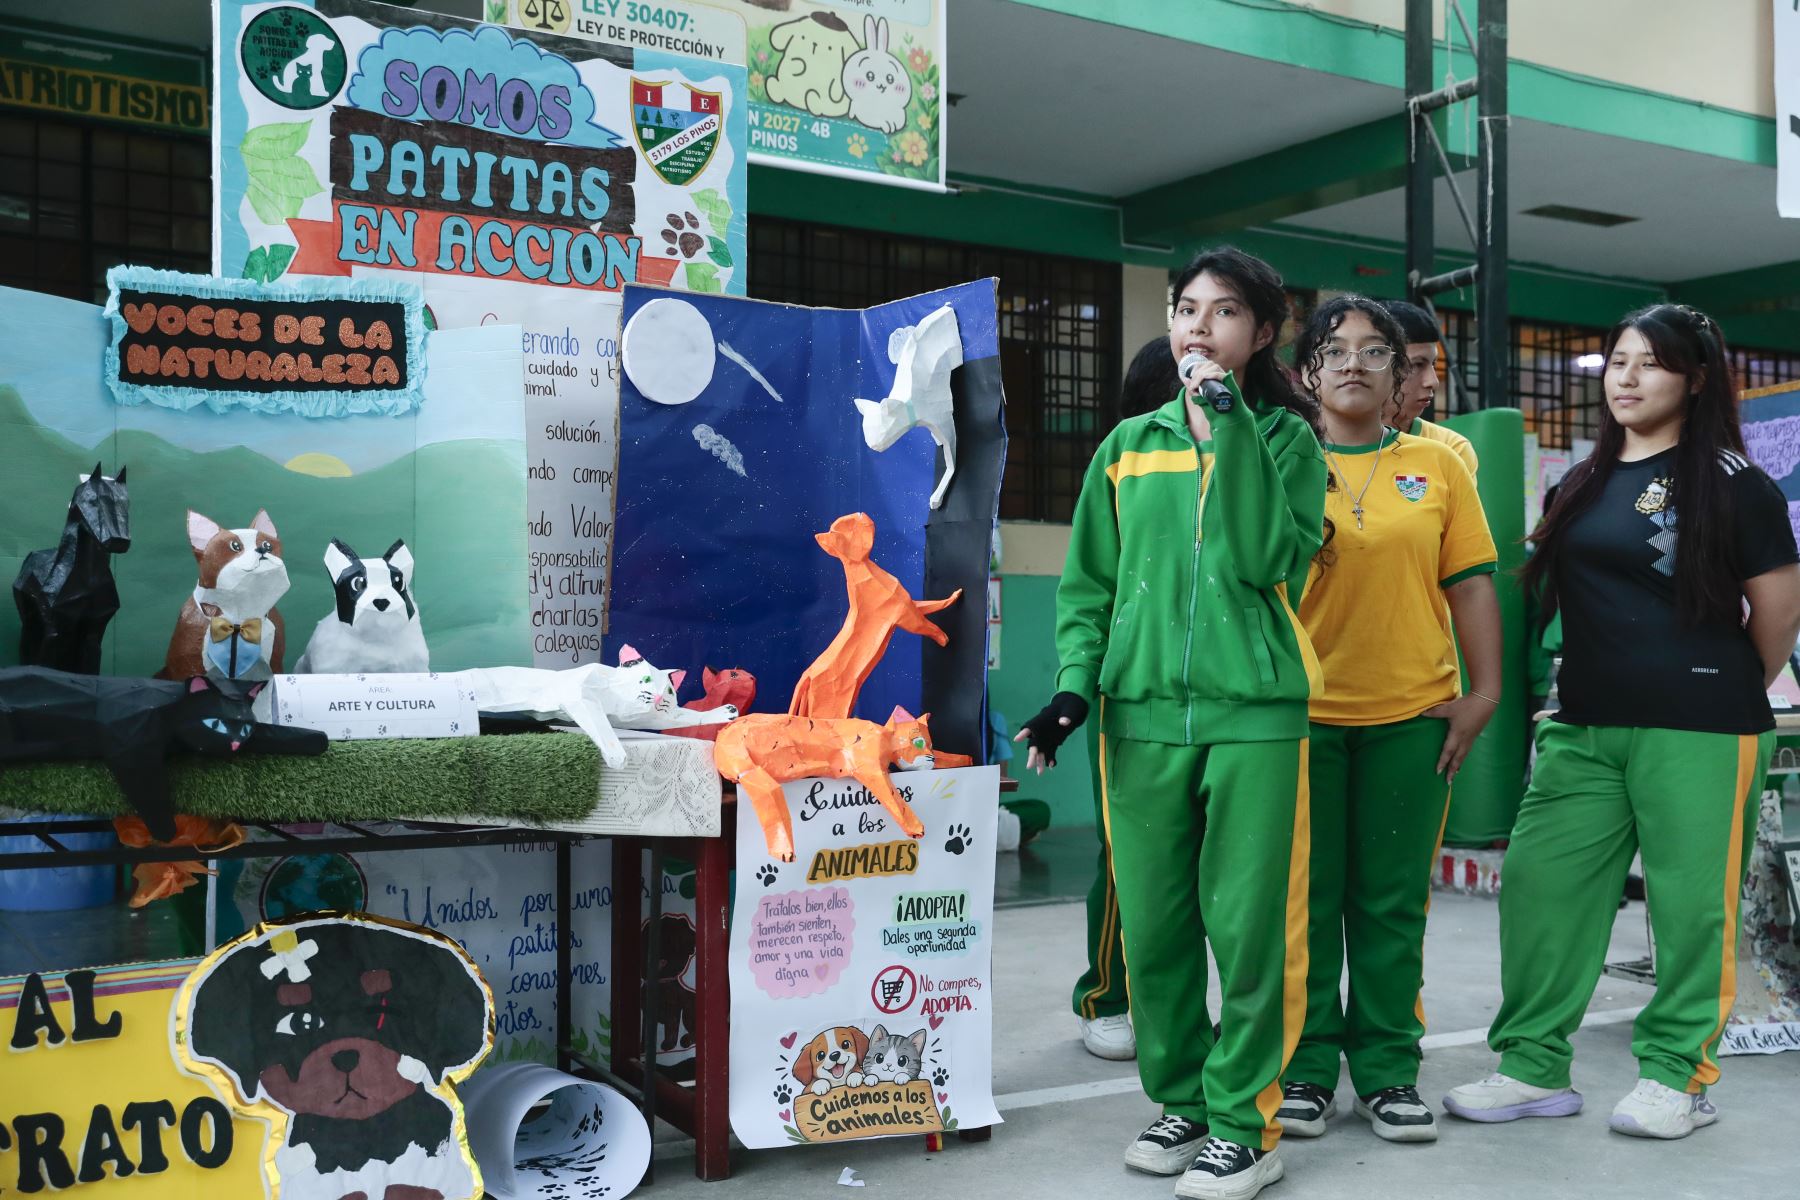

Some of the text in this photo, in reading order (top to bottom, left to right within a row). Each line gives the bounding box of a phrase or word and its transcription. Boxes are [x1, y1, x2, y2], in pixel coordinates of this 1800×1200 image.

[582, 0, 694, 33] LEY 30407:
[577, 19, 725, 59] LEY DE PROTECCIÓN Y
[382, 59, 572, 139] SOMOS
[646, 90, 710, 110] I E
[748, 109, 830, 138] N 2027 4B
[651, 118, 716, 161] 5179 LOS PINOS
[685, 149, 705, 157] ESTUDIO
[751, 129, 798, 152] PINOS
[349, 133, 610, 220] PATITAS
[661, 166, 692, 175] PATRIOTISMO
[337, 203, 418, 267] EN
[123, 302, 393, 350] VOCES DE LA
[126, 343, 400, 385] NATURALEZA
[528, 360, 578, 378] cuidado
[590, 368, 599, 387] y
[546, 420, 607, 443] solución.
[542, 574, 553, 599] y
[532, 599, 598, 627] charlas
[328, 699, 436, 712] ARTE Y CULTURA
[832, 811, 886, 836] a los
[809, 843, 917, 880] ANIMALES
[520, 893, 557, 927] por
[571, 886, 612, 910] una
[896, 893, 965, 923] ¡ADOPTA!
[508, 921, 583, 971] patits
[757, 928, 845, 949] merecen respeto,
[883, 924, 977, 946] Dales una segunda
[907, 938, 967, 957] oportunidad
[754, 946, 844, 965] amor y una vida
[775, 967, 809, 987] digna
[919, 974, 982, 996] No compres,
[10, 970, 122, 1049] AL
[810, 1087, 927, 1122] Cuidemos a los
[826, 1104, 925, 1134] animales
[0, 1096, 233, 1193] RATO
